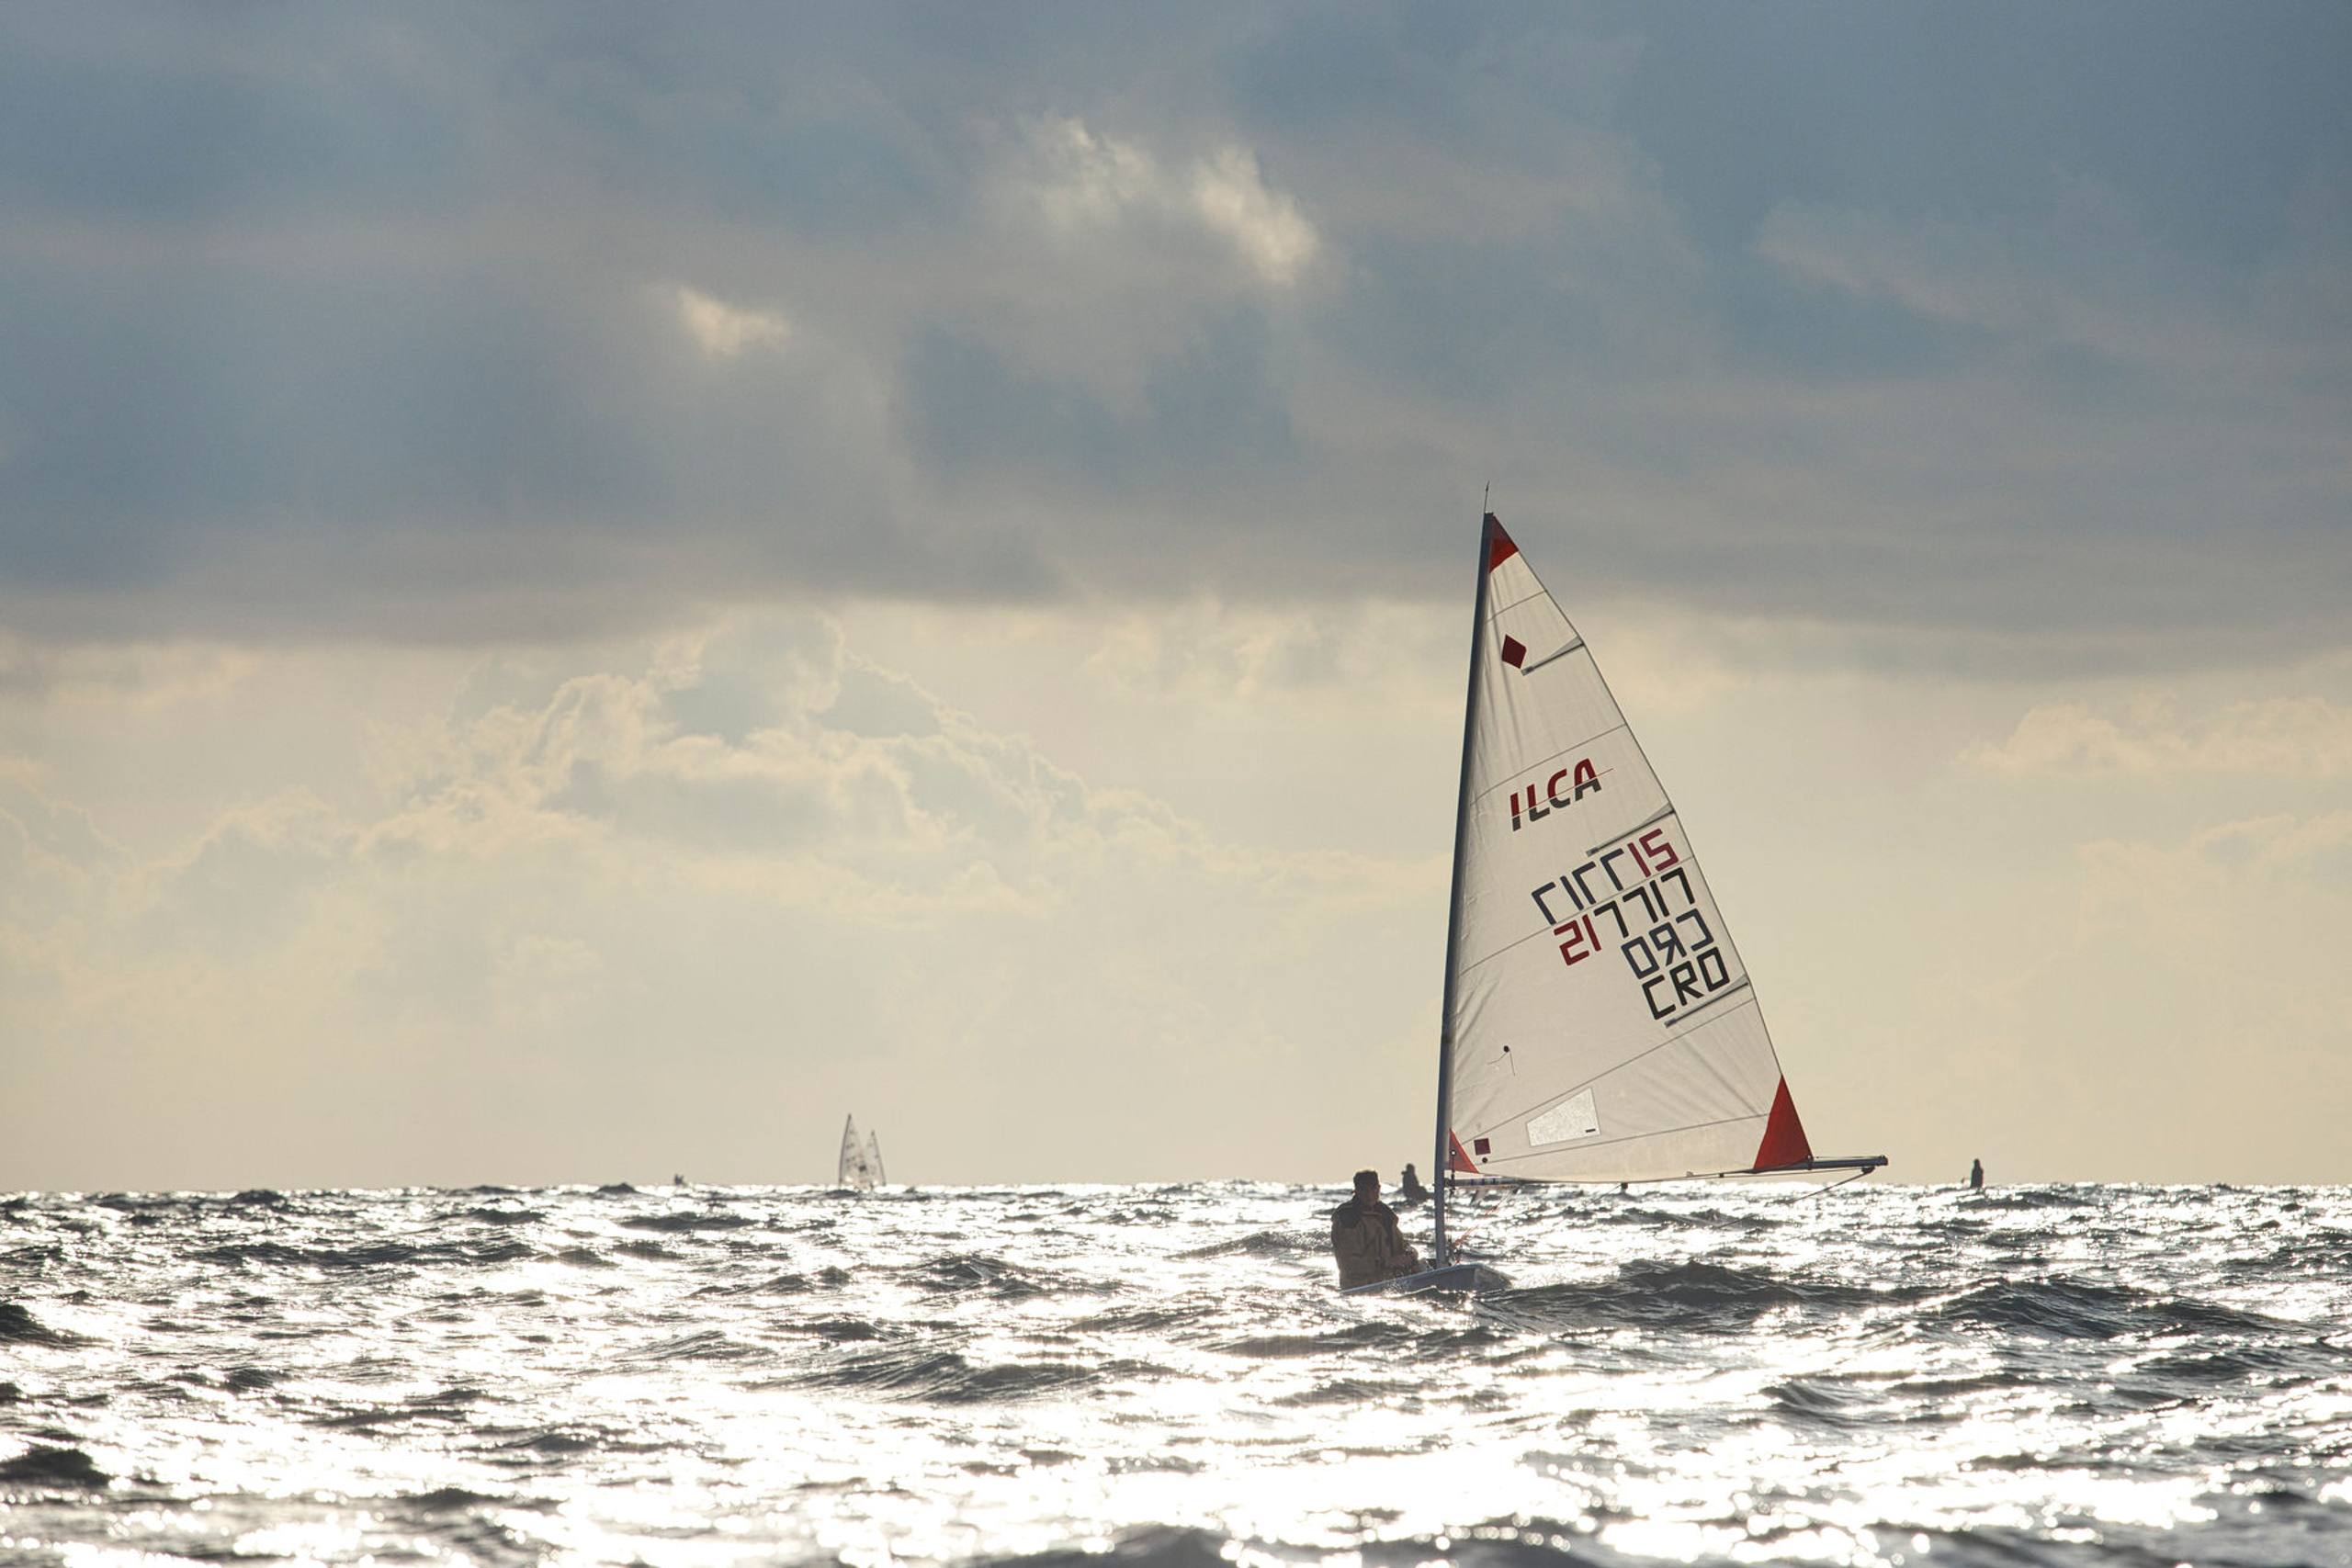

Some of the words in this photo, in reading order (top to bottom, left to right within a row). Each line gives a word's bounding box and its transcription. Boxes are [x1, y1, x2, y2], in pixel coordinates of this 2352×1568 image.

[1510, 758, 1601, 831] ILCA
[1554, 866, 1695, 966] 217717
[1642, 946, 1730, 1021] CRO
